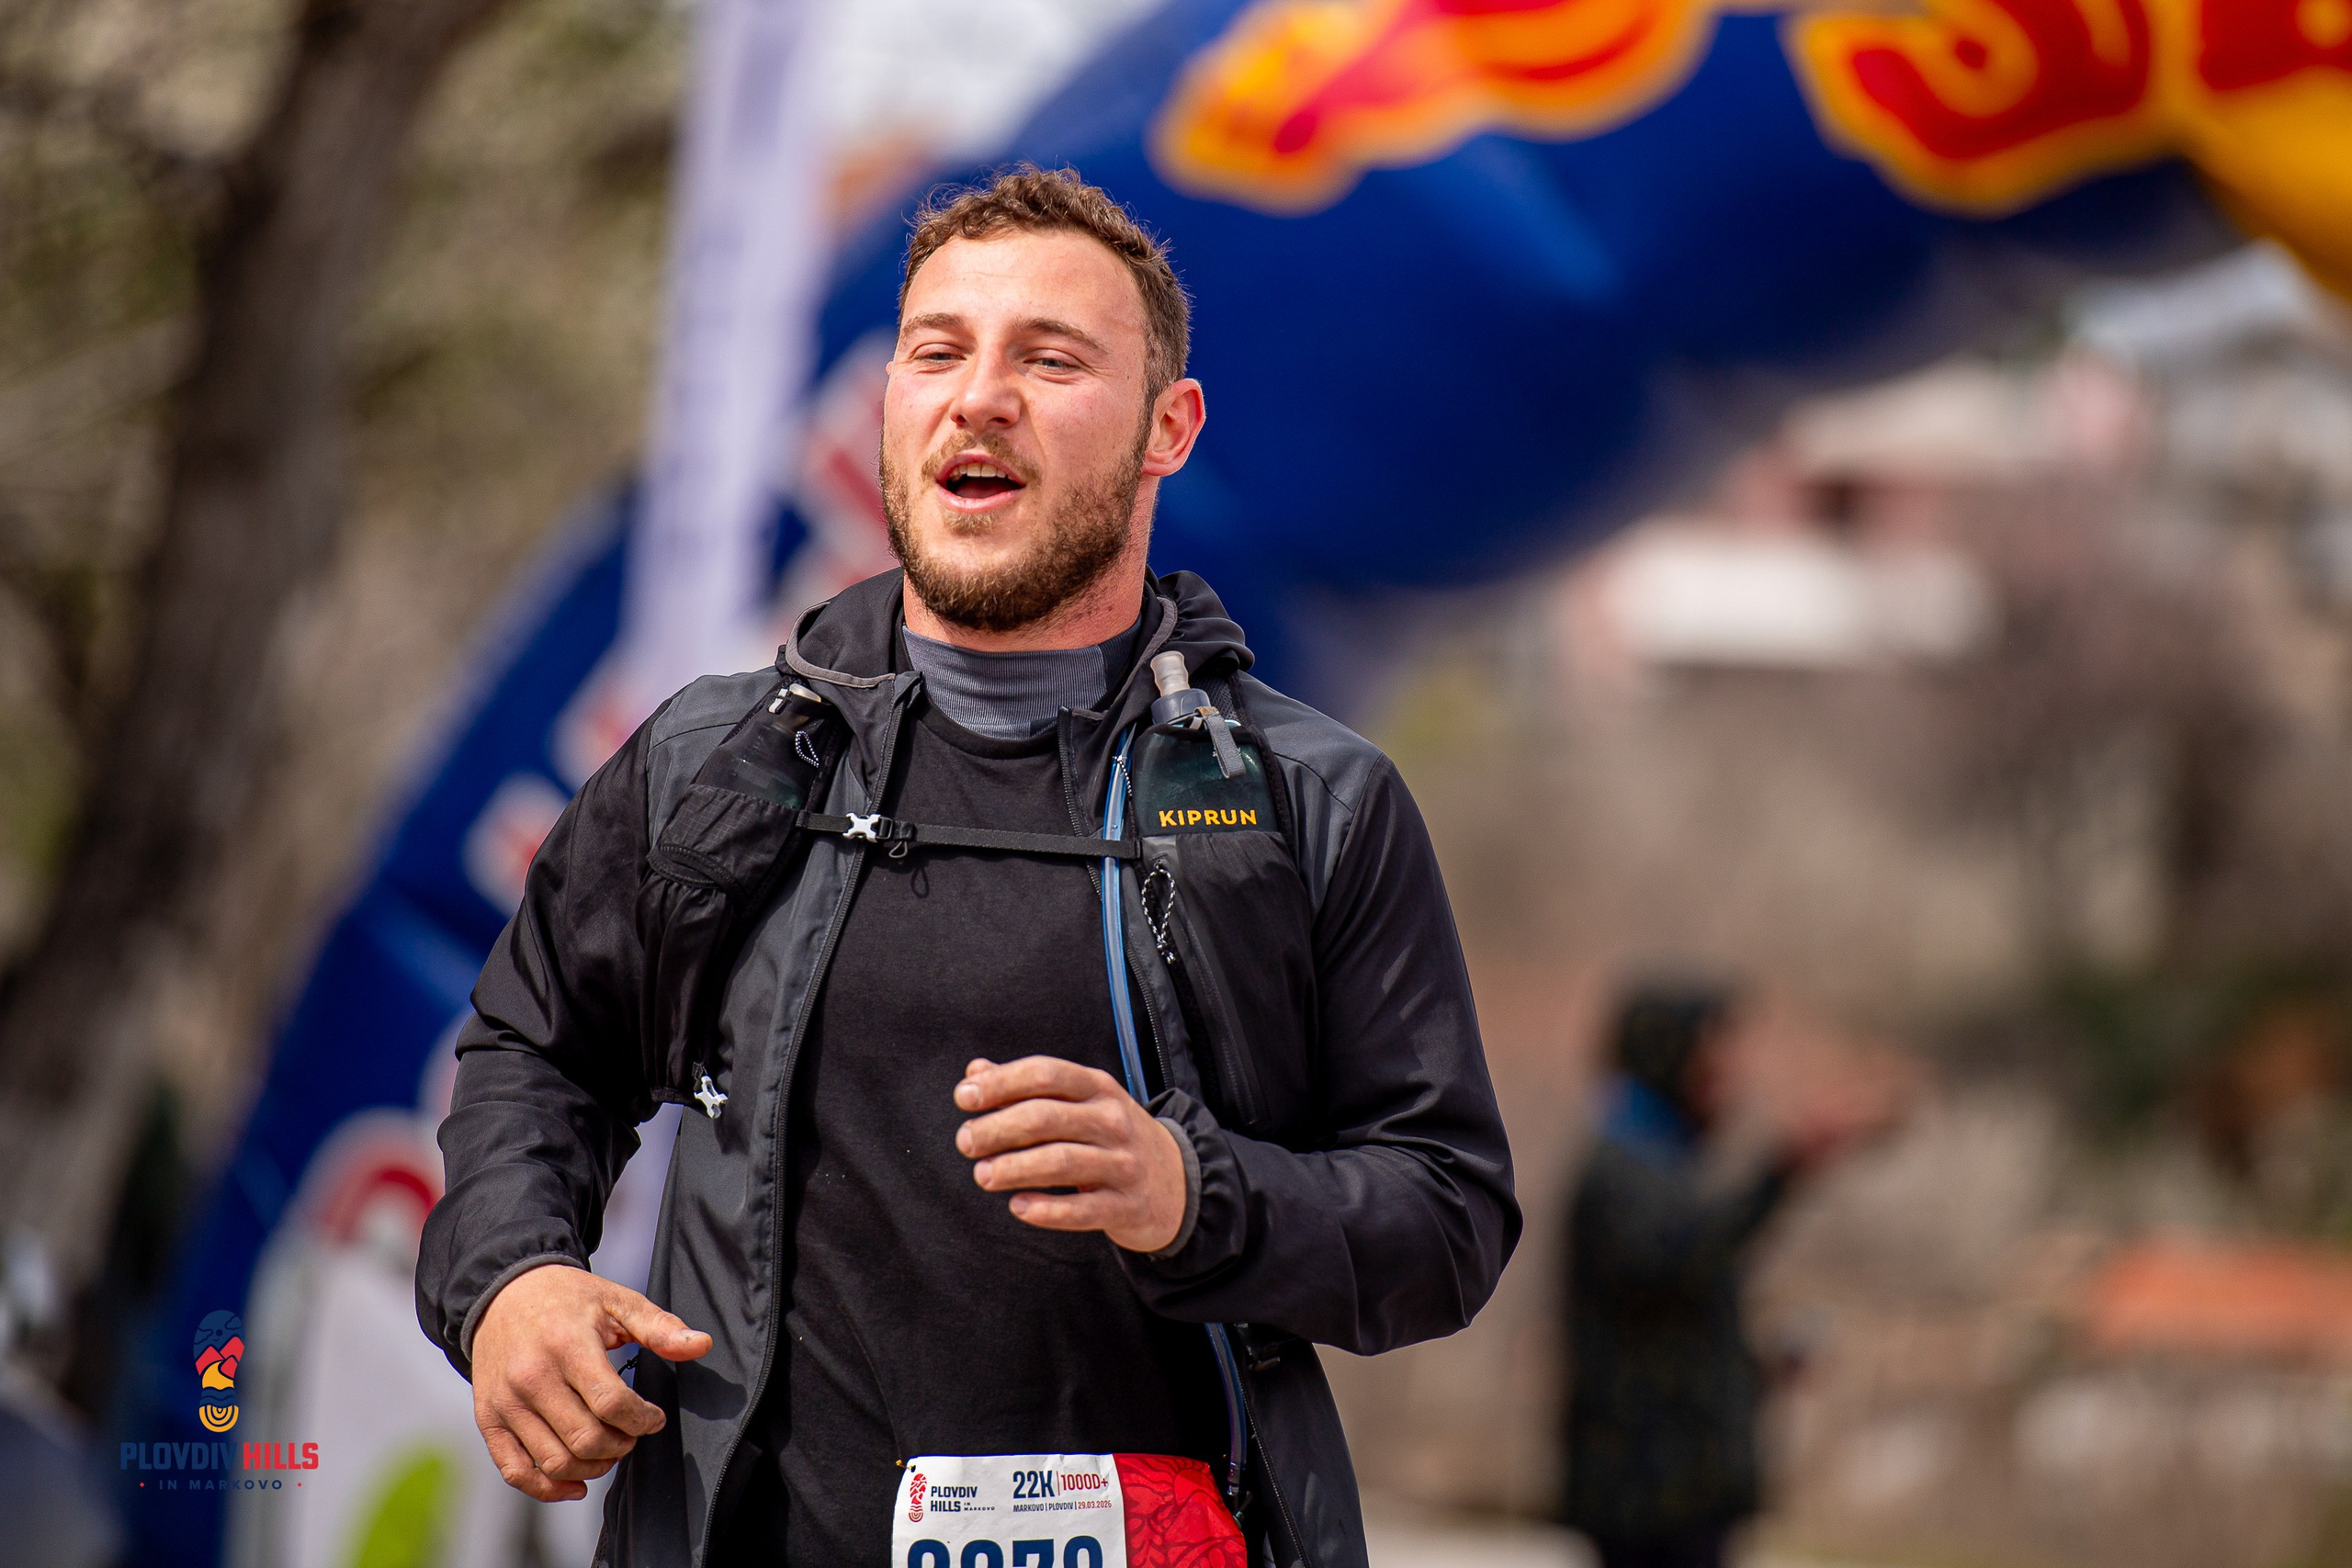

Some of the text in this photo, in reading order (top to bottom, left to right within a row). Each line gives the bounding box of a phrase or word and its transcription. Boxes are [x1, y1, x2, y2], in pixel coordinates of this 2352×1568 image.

[1159, 809, 1257, 827] KIPRUN
[1013, 1470, 1109, 1498] 22K 1000D+
[931, 1486, 978, 1498] PLOVDIV
[931, 1500, 961, 1511] HILLS
[1012, 1503, 1045, 1512] MARKOVO
[1048, 1502, 1074, 1511] PLOVDIV
